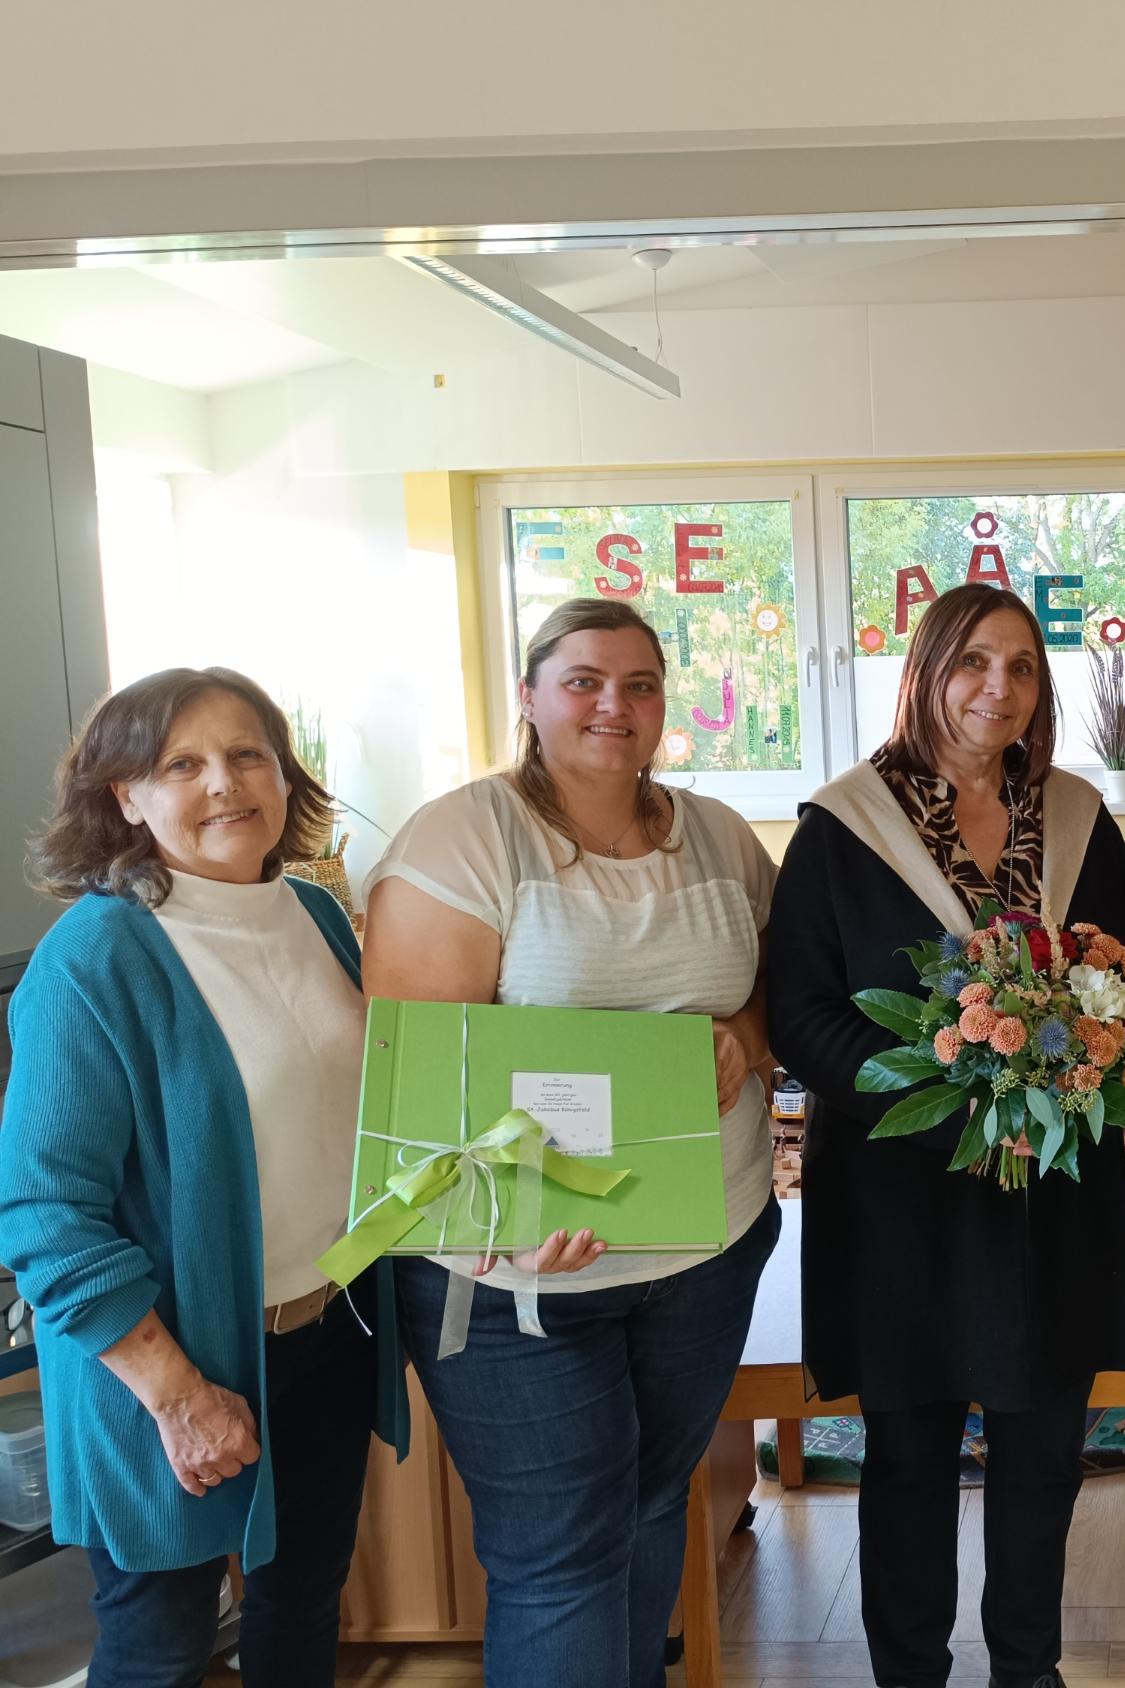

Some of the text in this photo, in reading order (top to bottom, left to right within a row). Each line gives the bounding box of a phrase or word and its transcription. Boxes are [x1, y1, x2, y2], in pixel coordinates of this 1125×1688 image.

[594, 533, 643, 600] S
[674, 523, 725, 594] E
[1033, 575, 1084, 646] E
[747, 706, 756, 754] HANNES
